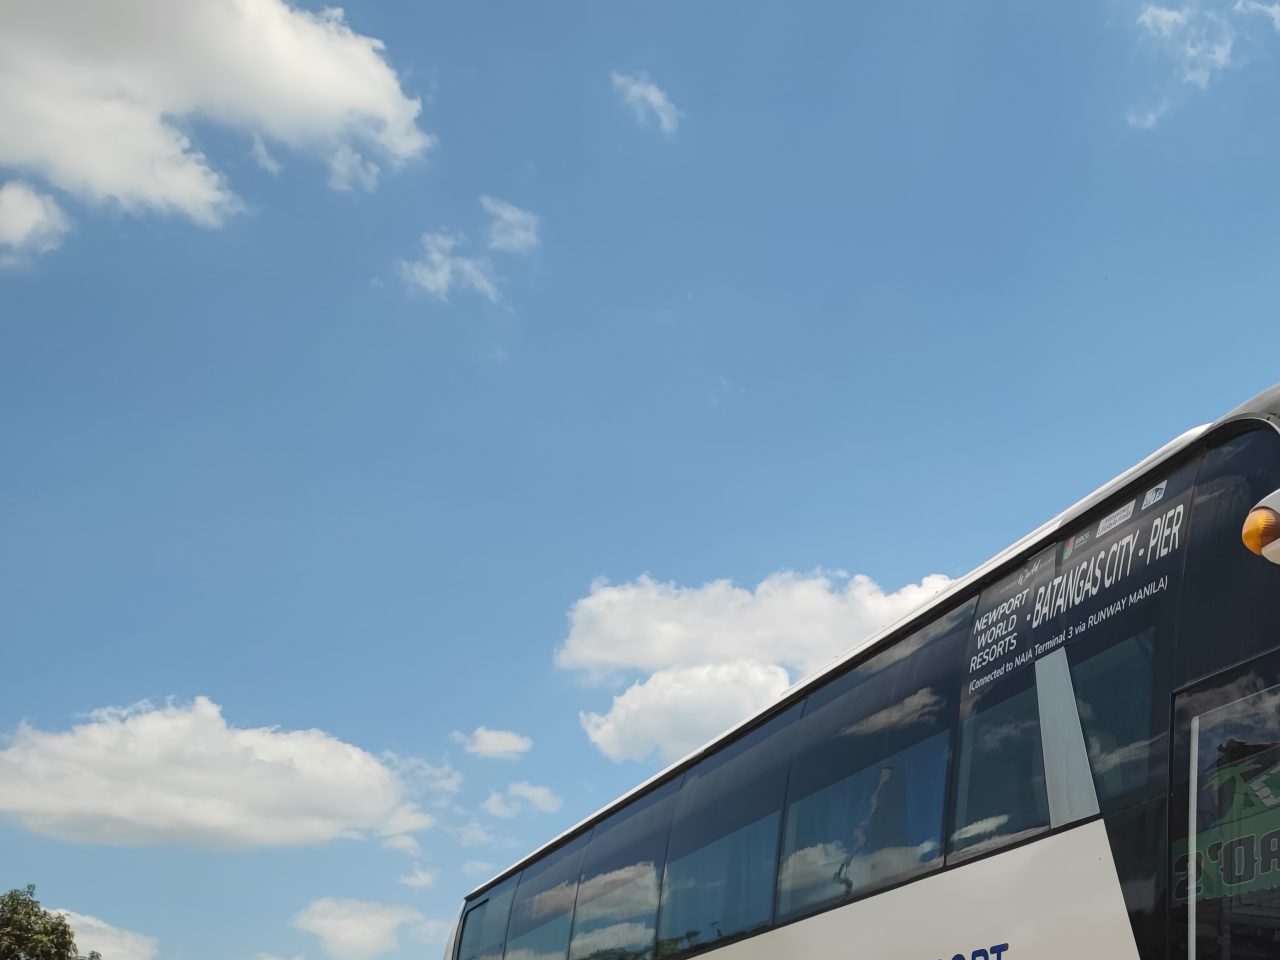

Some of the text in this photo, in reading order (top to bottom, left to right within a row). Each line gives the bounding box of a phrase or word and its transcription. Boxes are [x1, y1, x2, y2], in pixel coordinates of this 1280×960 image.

[1032, 550, 1105, 629] BATANGAS
[1104, 529, 1140, 589] CITY
[1146, 504, 1184, 566] PIER
[968, 574, 1168, 695] (Connected to NAIA Terminal 3 via RUNWAY MANILA)
[973, 588, 1030, 635] NEWPORT
[977, 614, 1017, 650] WORLD
[969, 632, 1018, 674] RESORTS
